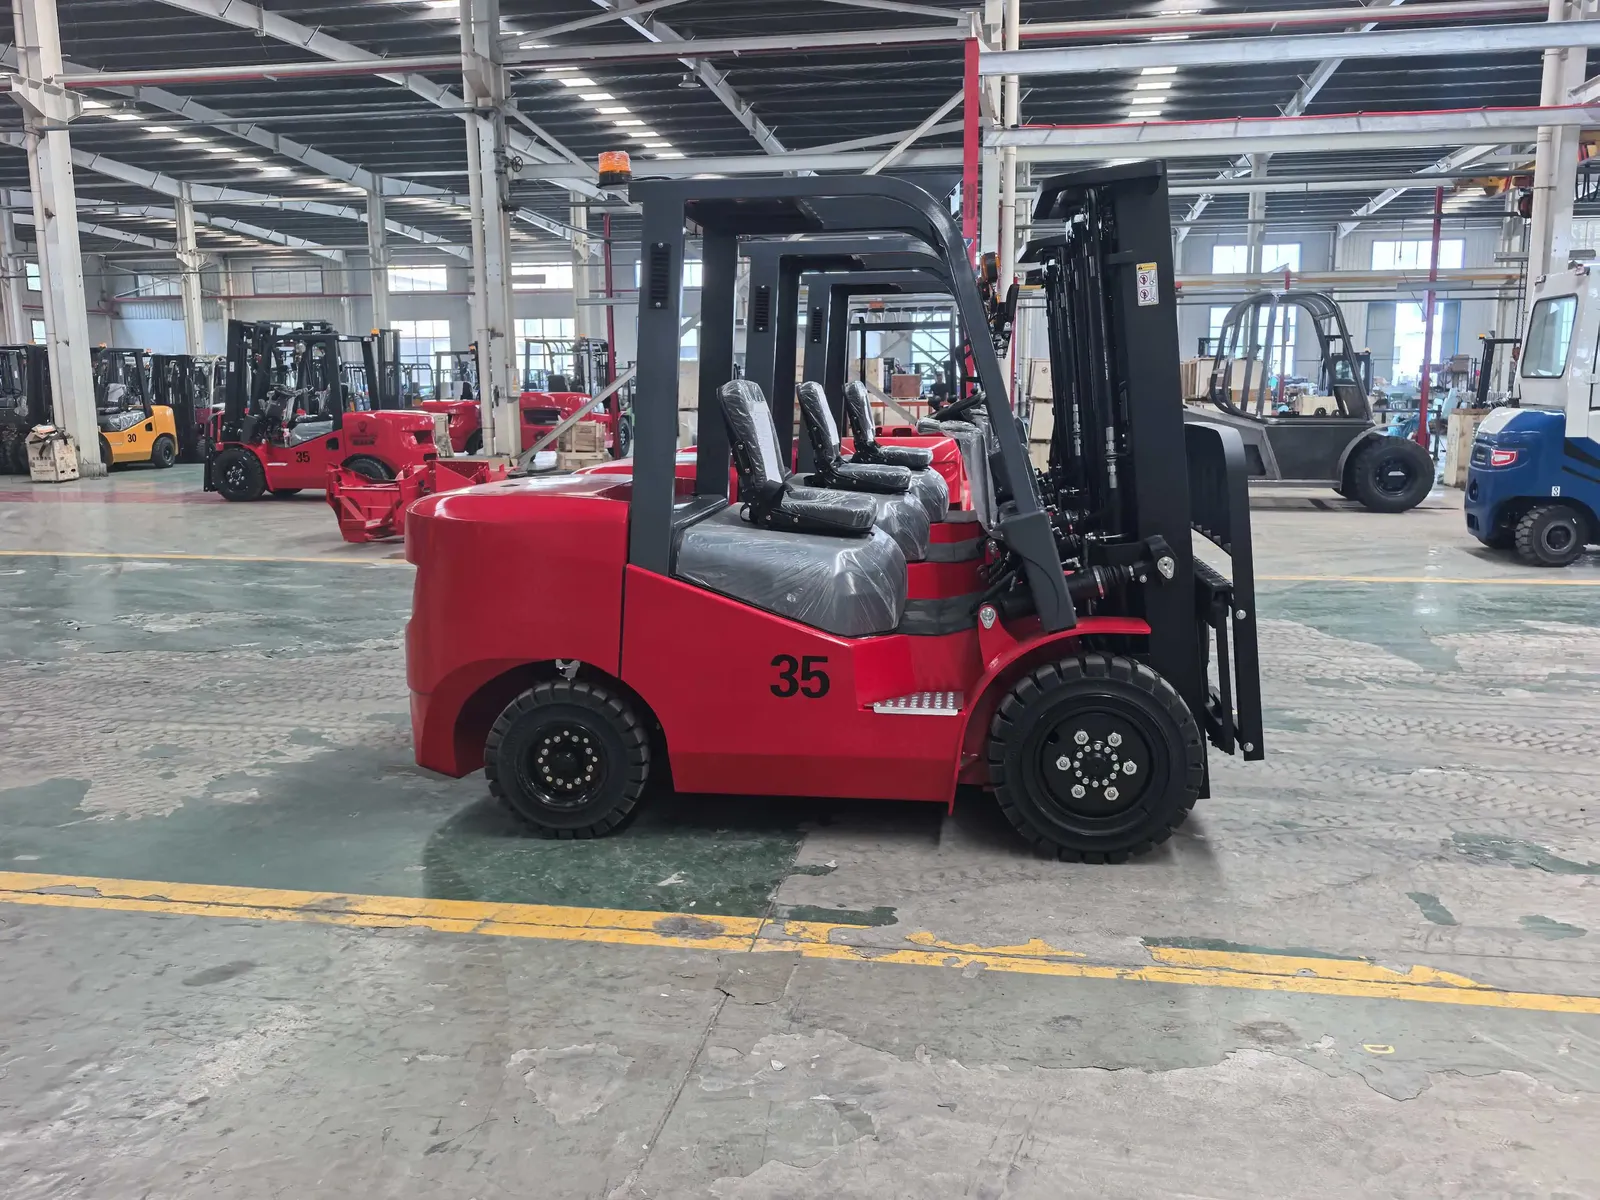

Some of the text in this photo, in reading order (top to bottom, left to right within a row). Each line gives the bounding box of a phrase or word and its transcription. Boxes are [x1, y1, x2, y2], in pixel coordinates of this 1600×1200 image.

[127, 433, 137, 443] 30
[295, 451, 311, 463] 35
[770, 654, 830, 699] 35
